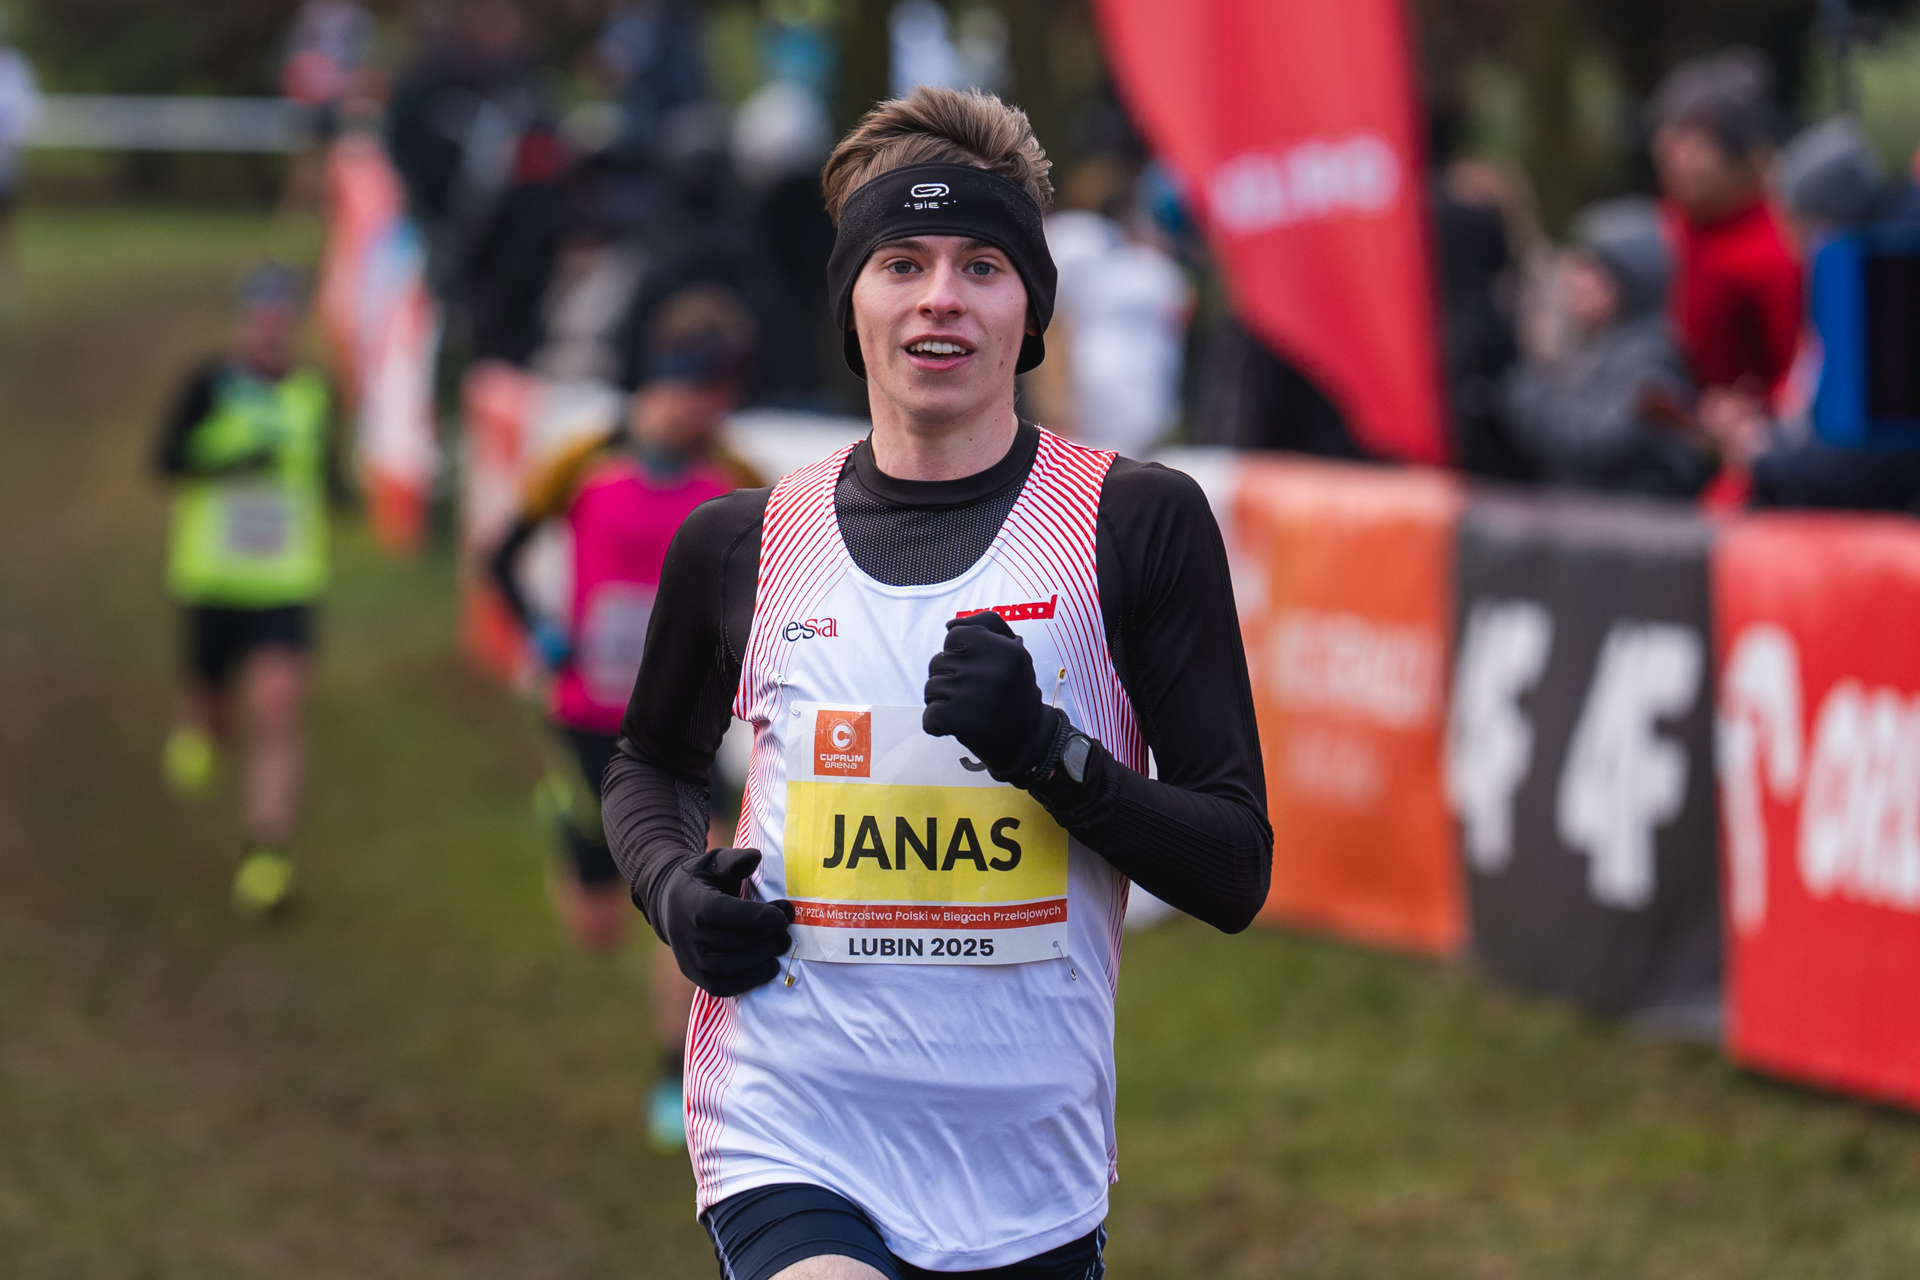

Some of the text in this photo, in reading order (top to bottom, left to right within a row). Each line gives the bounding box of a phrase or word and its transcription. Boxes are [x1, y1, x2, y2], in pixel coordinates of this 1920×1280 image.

[820, 753, 864, 763] CUPRUM
[823, 814, 1022, 872] JANAS
[794, 906, 805, 917] 97.
[826, 909, 893, 921] Mistrzostwa
[895, 911, 928, 921] Polski
[931, 913, 941, 921] w
[944, 911, 991, 924] Biegach
[993, 904, 1061, 922] Przełajowych
[849, 938, 994, 956] LUBIN 2025
